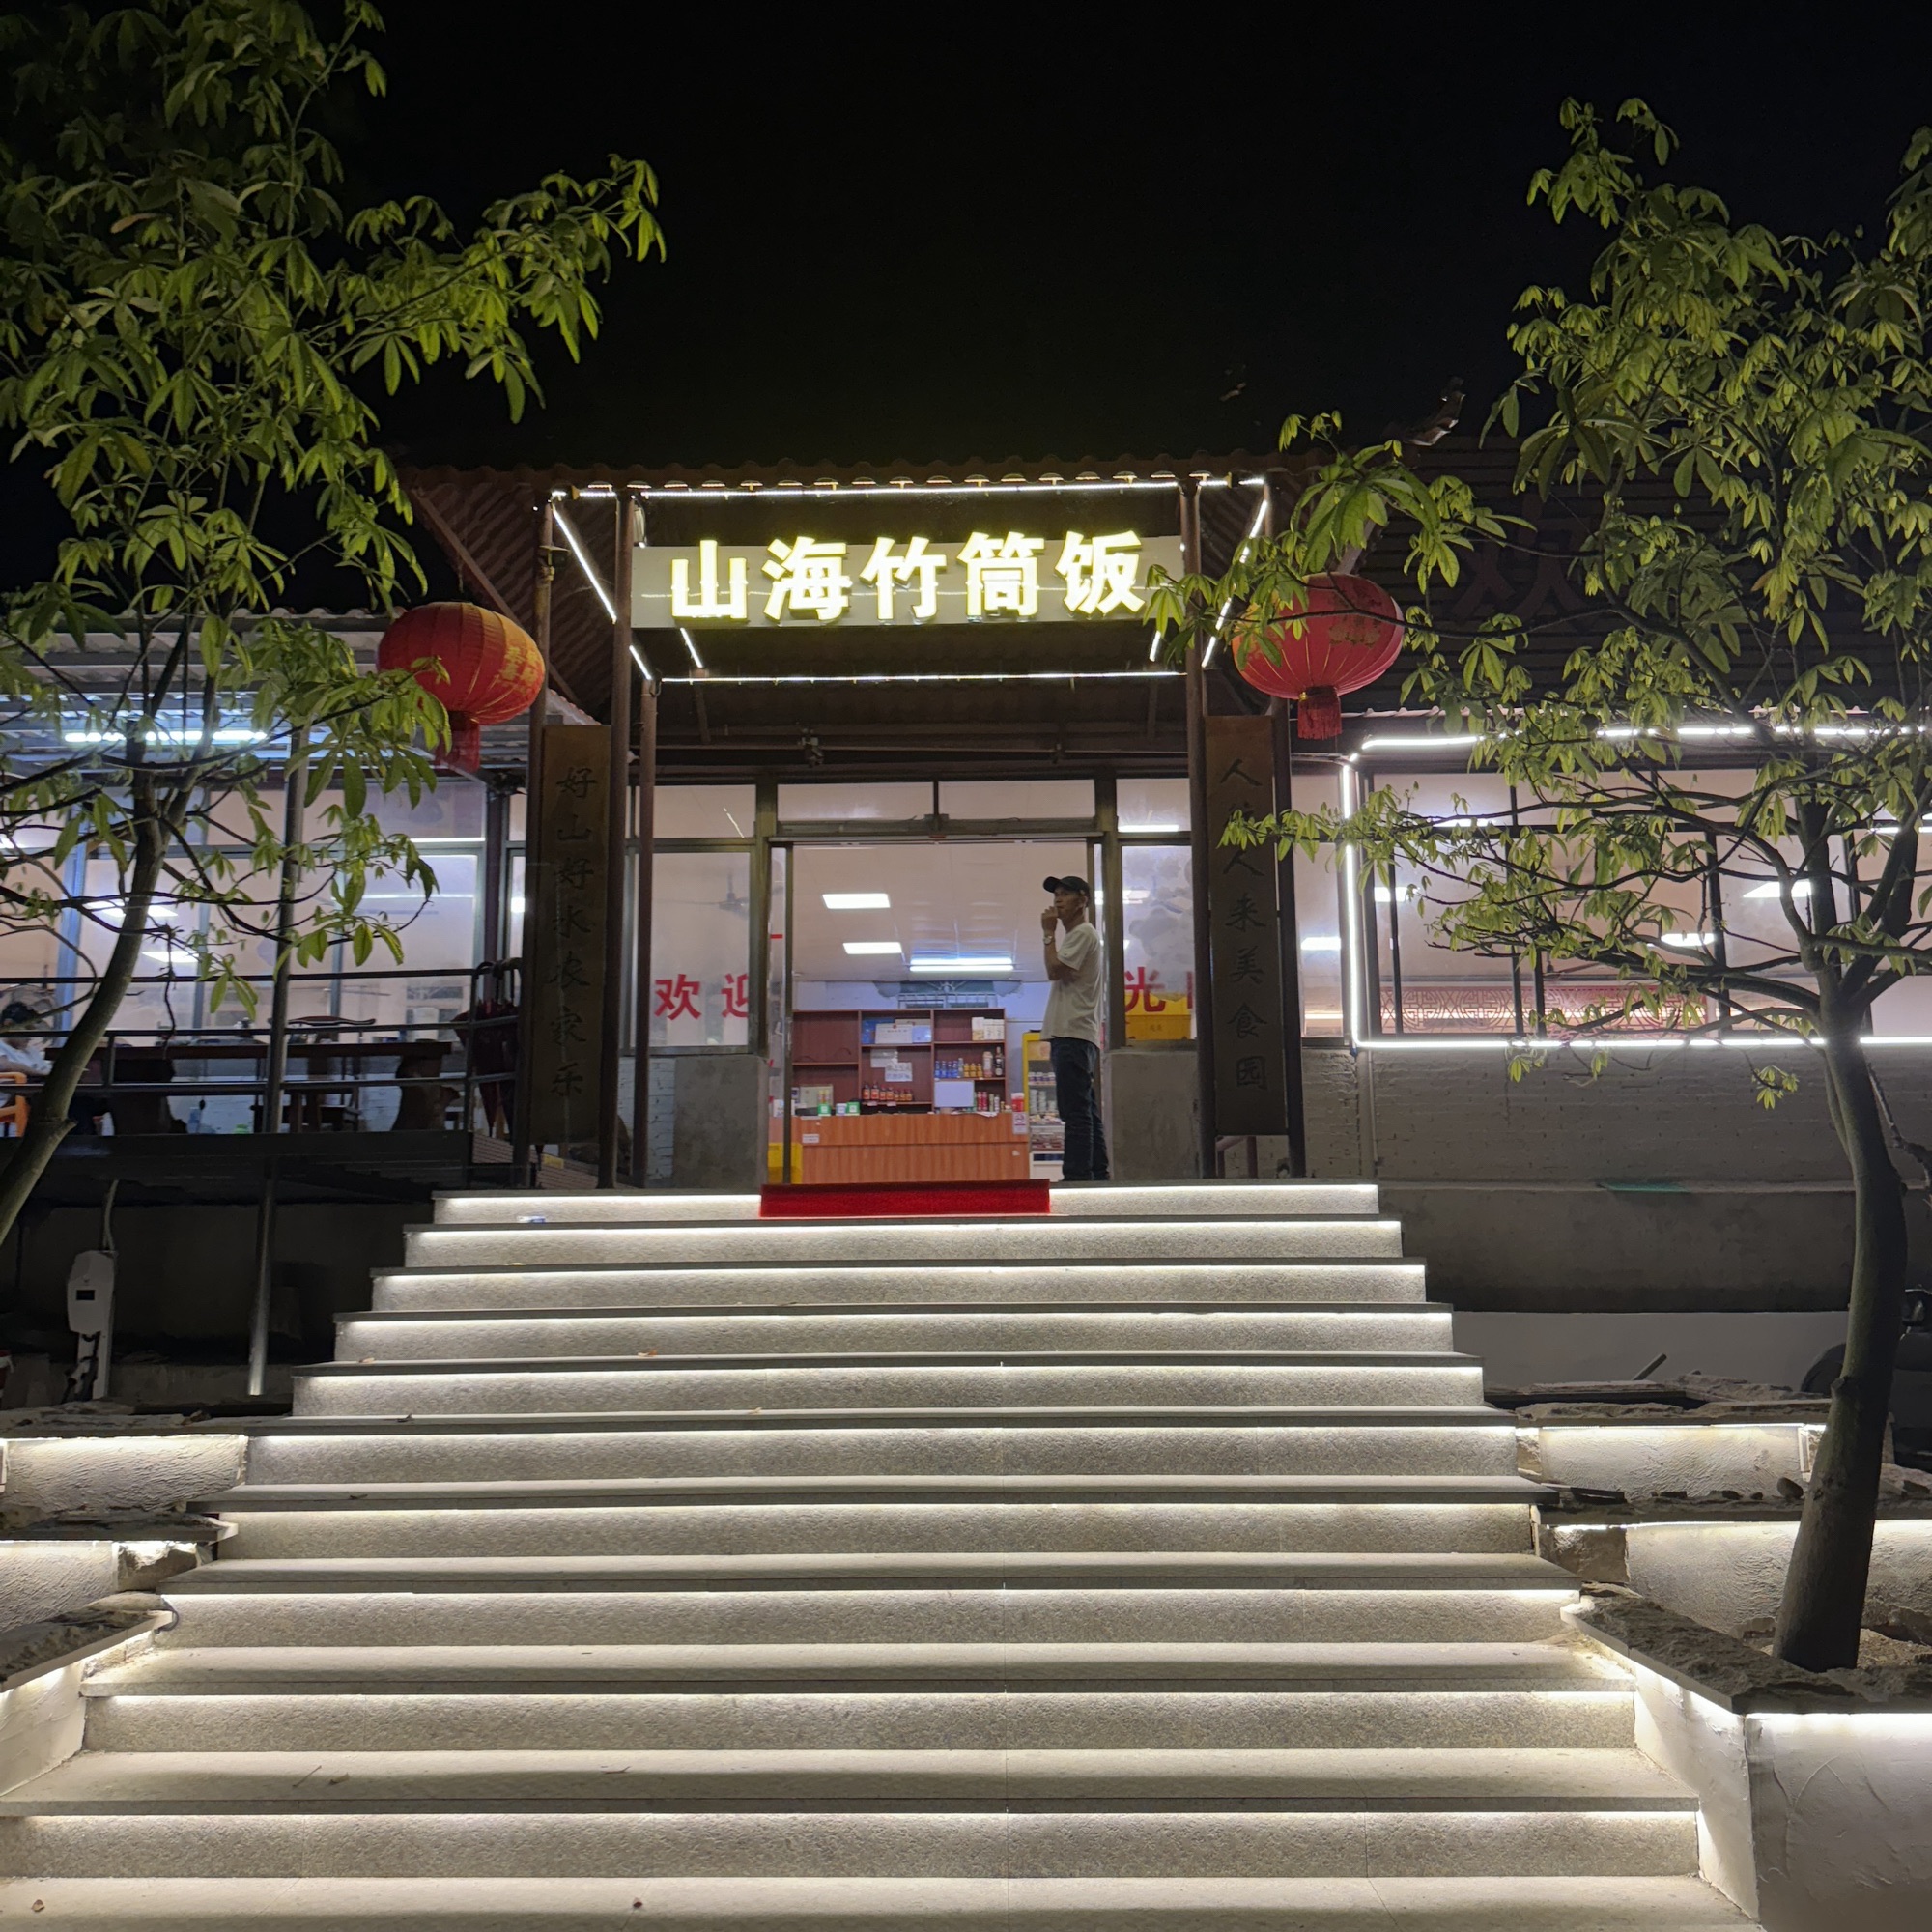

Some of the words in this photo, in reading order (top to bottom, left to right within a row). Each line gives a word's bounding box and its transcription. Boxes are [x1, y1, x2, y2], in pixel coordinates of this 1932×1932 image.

[670, 530, 1147, 623] 山海竹筒饭
[547, 766, 598, 1098] 好山好水农家乐
[1124, 966, 1193, 1013] 光
